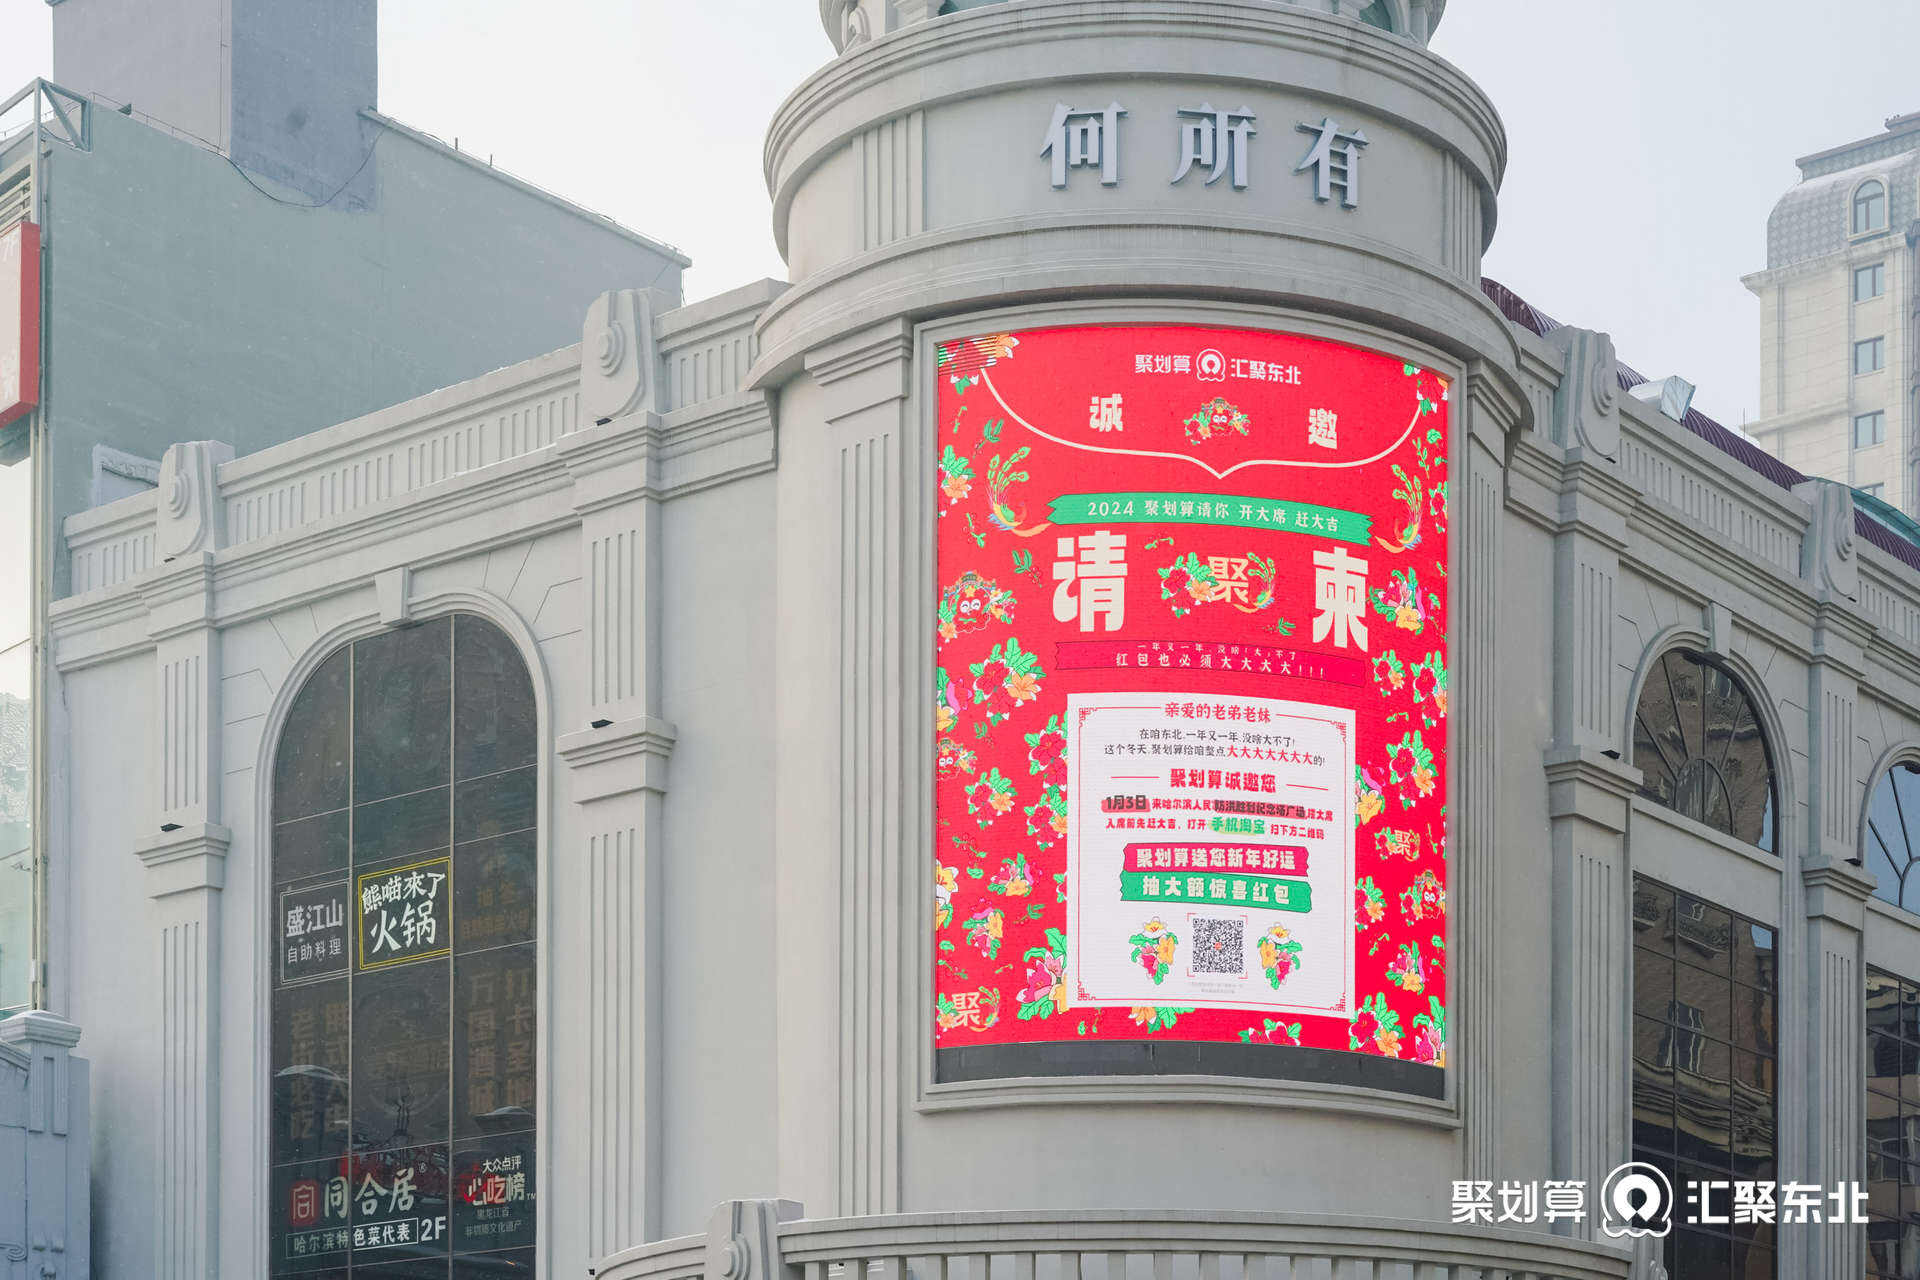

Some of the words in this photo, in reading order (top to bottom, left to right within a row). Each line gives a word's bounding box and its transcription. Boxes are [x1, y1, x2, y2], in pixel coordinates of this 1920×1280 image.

[1039, 100, 1370, 209] 何所有
[1135, 354, 1192, 374] 聚划算
[1230, 358, 1302, 385] 汇聚东北
[1089, 393, 1123, 433] 诚
[1308, 407, 1338, 449] 邀
[1087, 500, 1136, 517] 2024
[1144, 500, 1231, 519] 聚划算请你
[1239, 504, 1287, 525] 开大席
[1294, 511, 1340, 532] 赶大吉
[1052, 530, 1128, 633] 请
[1207, 555, 1251, 603] 聚
[1164, 702, 1272, 724] 亲爱的老弟老妹
[1169, 768, 1277, 794] 聚划算诚邀您
[1105, 795, 1147, 811] 1月3日
[1210, 816, 1266, 835] 手机淘宝
[1136, 847, 1297, 870] 聚划算送您新年好运
[1142, 875, 1290, 905] 抽大额惊喜红包
[286, 898, 343, 938] 盛江山
[370, 899, 437, 954] 火锅
[287, 936, 342, 964] 自助料理
[482, 1155, 522, 1174] 大众点评
[324, 1167, 417, 1219] 同合居
[465, 1172, 526, 1206] 必吃榜
[293, 1222, 411, 1254] 哈尔滨特色菜代表
[420, 1216, 447, 1242] 2F
